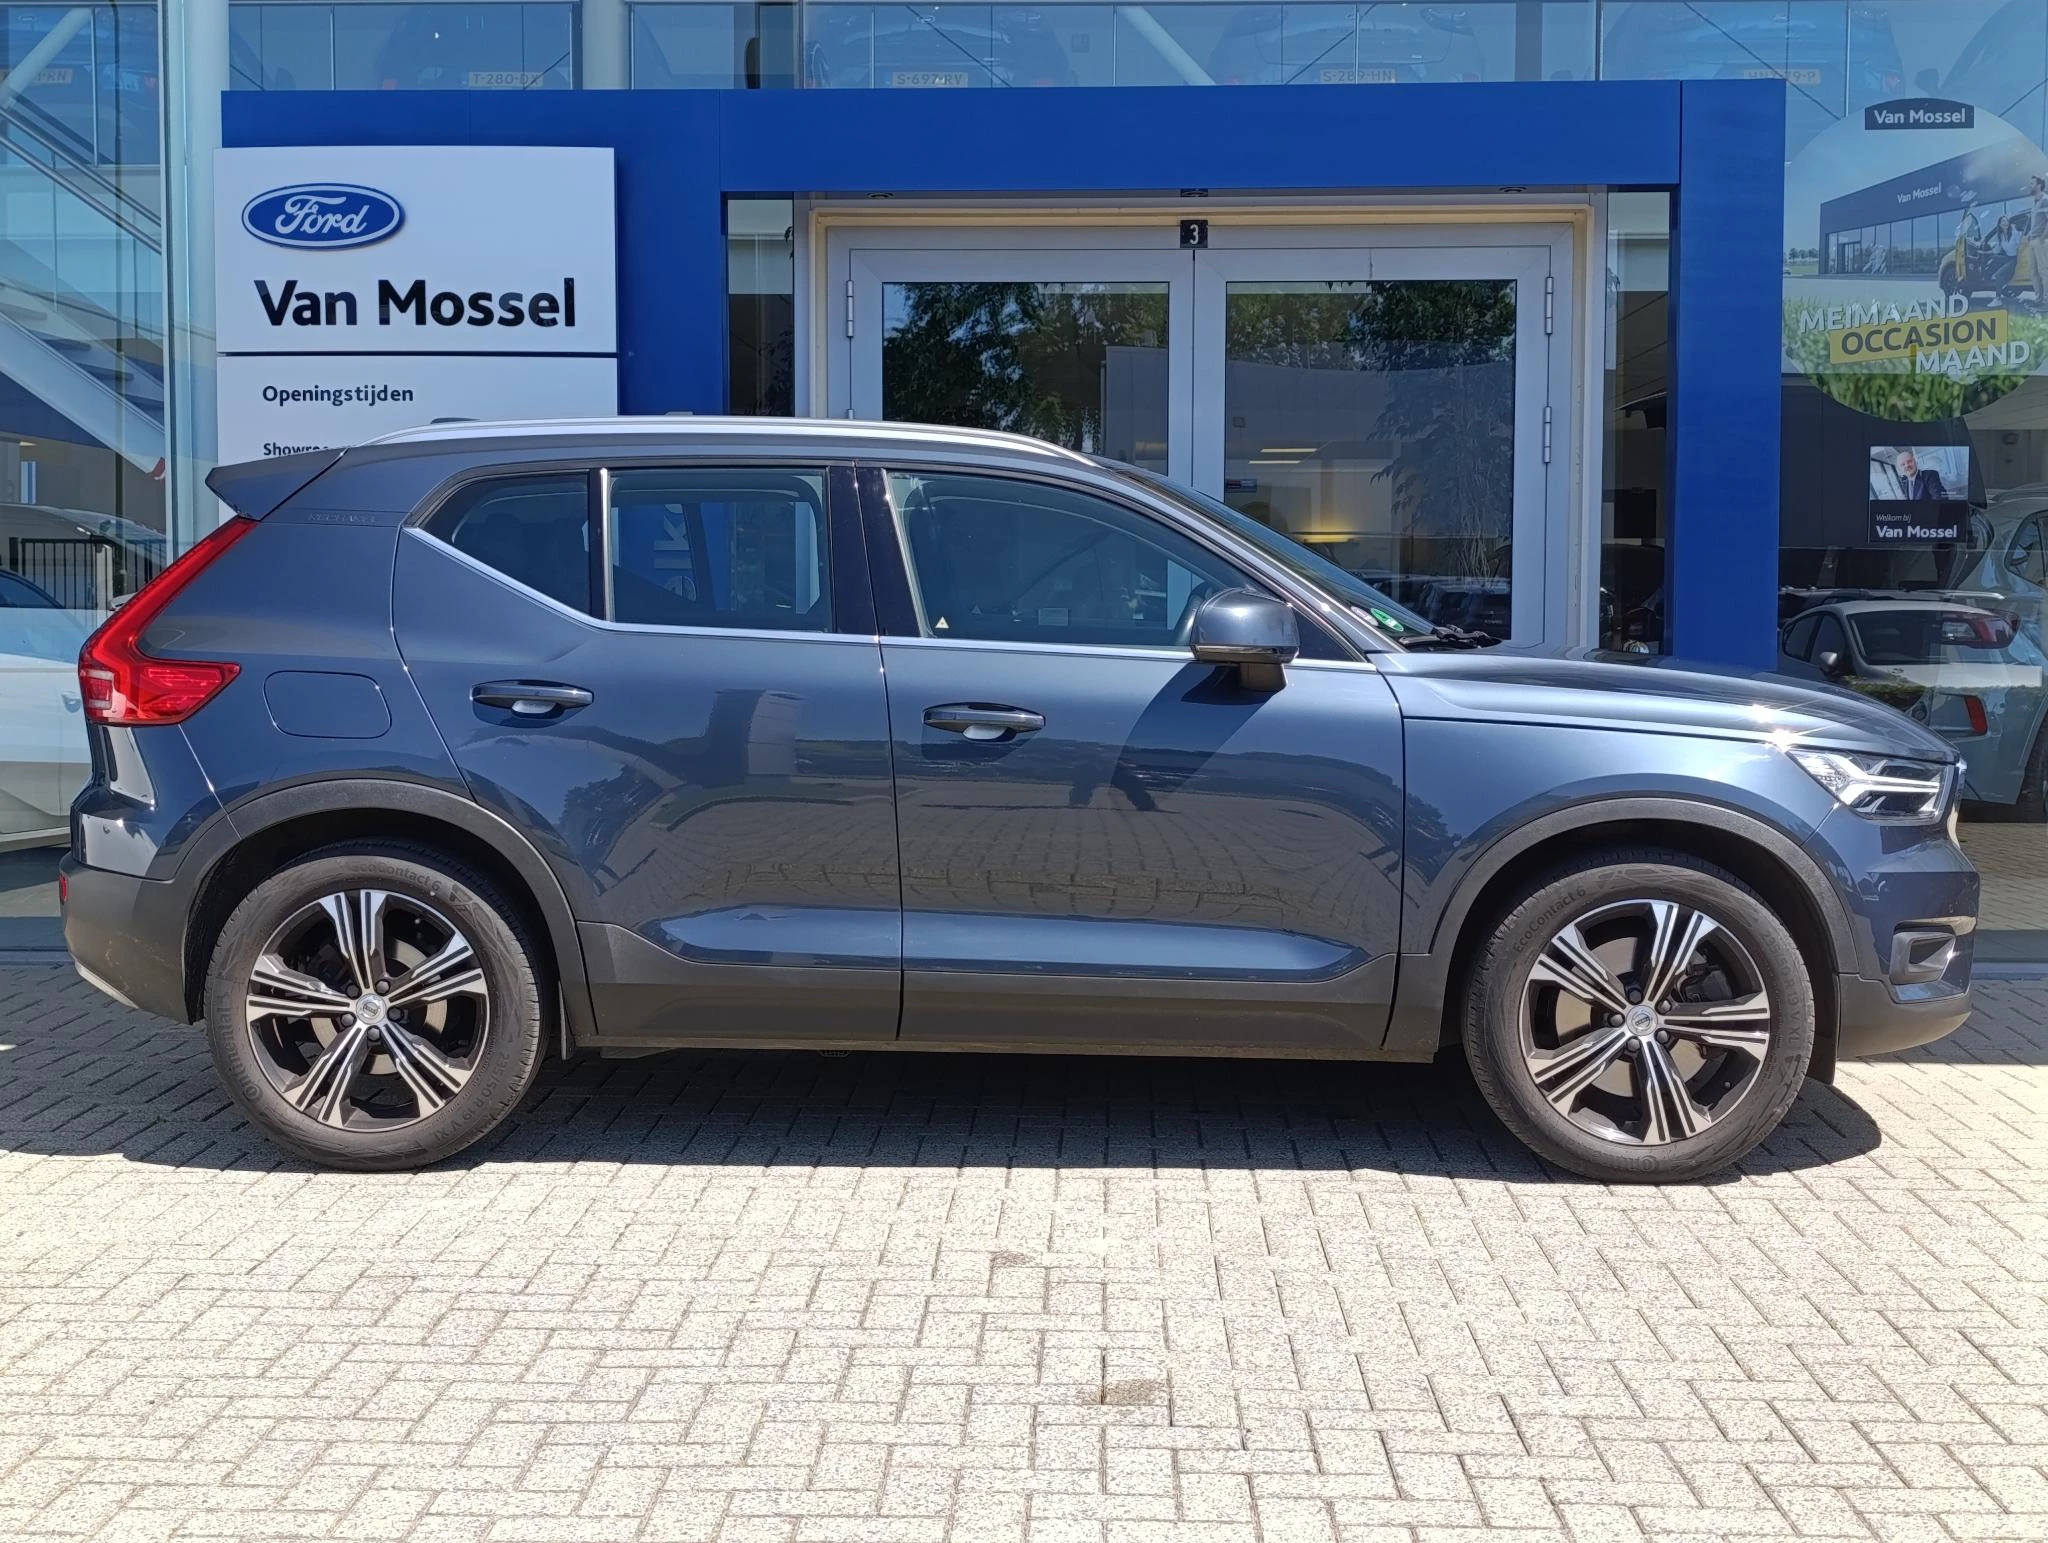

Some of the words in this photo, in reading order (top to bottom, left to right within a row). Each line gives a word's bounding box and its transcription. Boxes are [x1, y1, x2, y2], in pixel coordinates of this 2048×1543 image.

[472, 73, 538, 85] T-280-DX
[896, 73, 962, 85] S-697-RV
[1873, 109, 1905, 124] Van
[1909, 108, 1966, 123] Mossel
[1897, 193, 1912, 204] Van
[1913, 181, 1942, 200] Mossel
[275, 194, 371, 235] Ford
[1190, 224, 1199, 245] 3
[253, 279, 358, 327] Van
[378, 277, 576, 327] Mossel
[1800, 295, 1970, 333] MEIMAAND
[1841, 317, 1997, 355] OCCASION
[1916, 340, 2031, 374] MAAND
[262, 385, 414, 407] Openingstijden
[1876, 525, 1903, 538] Van
[1907, 524, 1958, 538] Mossel
[1513, 891, 1576, 953] EcoContact
[1576, 884, 1586, 897] 6
